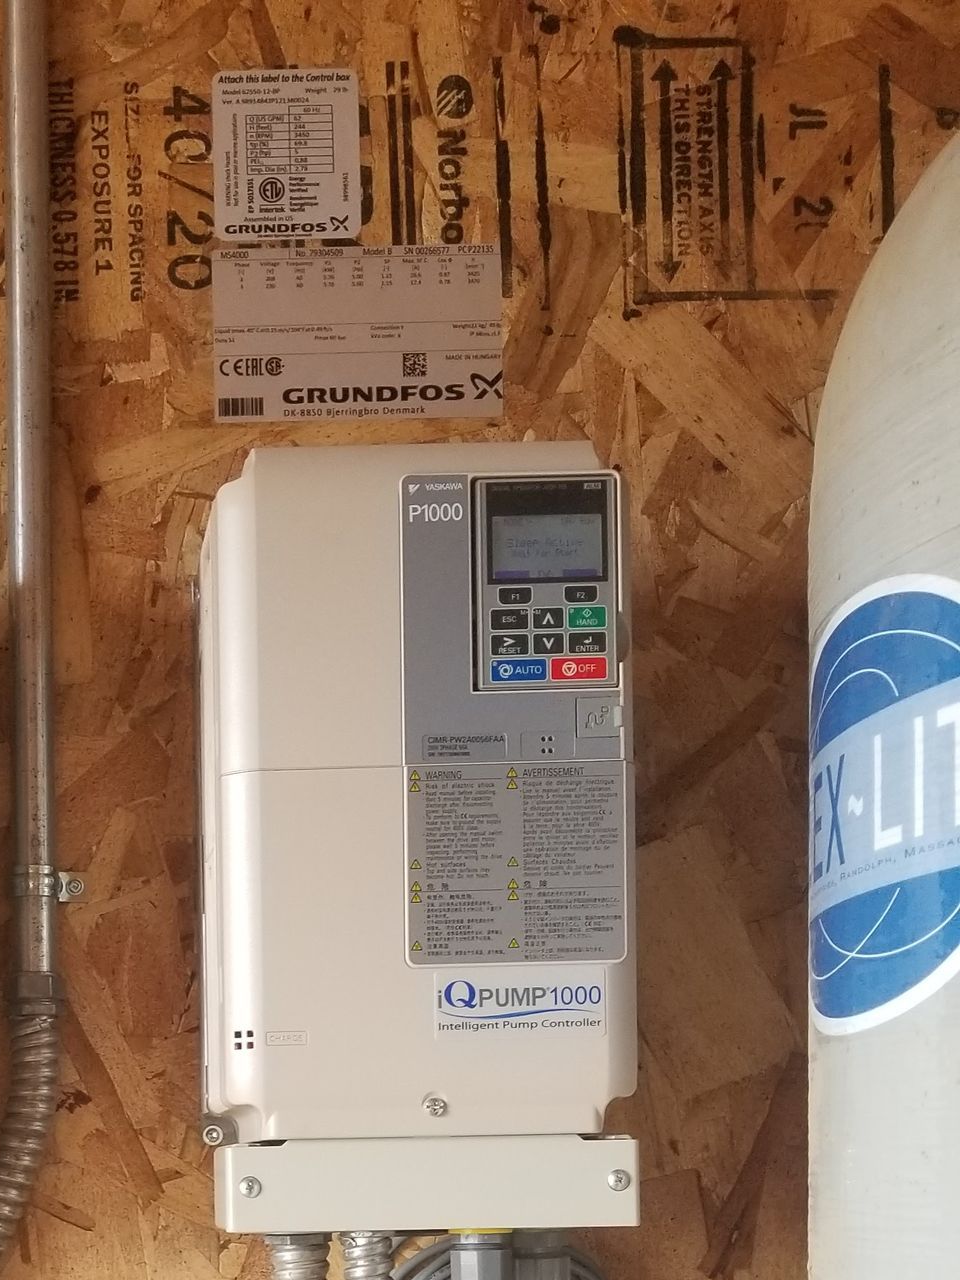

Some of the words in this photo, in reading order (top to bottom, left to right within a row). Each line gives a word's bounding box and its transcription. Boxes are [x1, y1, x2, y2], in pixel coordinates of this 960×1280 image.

[218, 74, 244, 84] Attach
[245, 73, 260, 84] this
[261, 73, 280, 83] label
[281, 74, 290, 83] to
[291, 73, 304, 83] the
[305, 73, 335, 83] Control
[336, 72, 351, 82] box
[674, 83, 691, 135] THIS
[695, 83, 716, 195] STRENGTH
[90, 110, 113, 252] EXPOSURE
[158, 86, 215, 291] 40/20
[674, 142, 692, 257] DIRECTION
[259, 205, 286, 213] Intertek
[224, 222, 327, 235] GRUNDFOS
[698, 206, 716, 257] AXIS
[51, 208, 79, 272] 0.578
[127, 203, 146, 303] SPACING
[220, 250, 249, 259] MS4000
[309, 249, 344, 257] 79304509
[362, 248, 386, 256] Model
[387, 247, 393, 255] B
[403, 247, 414, 255] SN
[95, 259, 114, 277] 1
[472, 353, 502, 361] HUNGARY
[282, 384, 466, 405] GRUNDFOS
[283, 408, 323, 418] DK-8850
[326, 407, 380, 418] Bjerringbro
[383, 406, 426, 415] Denmark
[425, 482, 464, 491] YASKAWA
[408, 503, 463, 523] P1000
[511, 593, 521, 601] F1
[502, 615, 517, 624] ESC
[576, 617, 598, 626] HAND
[498, 647, 522, 655] RESET
[575, 645, 600, 653] ENTER
[515, 665, 543, 674] AUTO
[578, 664, 597, 673] OFF
[425, 770, 462, 780] WARNING
[522, 766, 585, 777] AVERTISSEMENT
[438, 1021, 500, 1032] Intelligent
[503, 1020, 538, 1030] Pump
[541, 1018, 602, 1029] Controller
